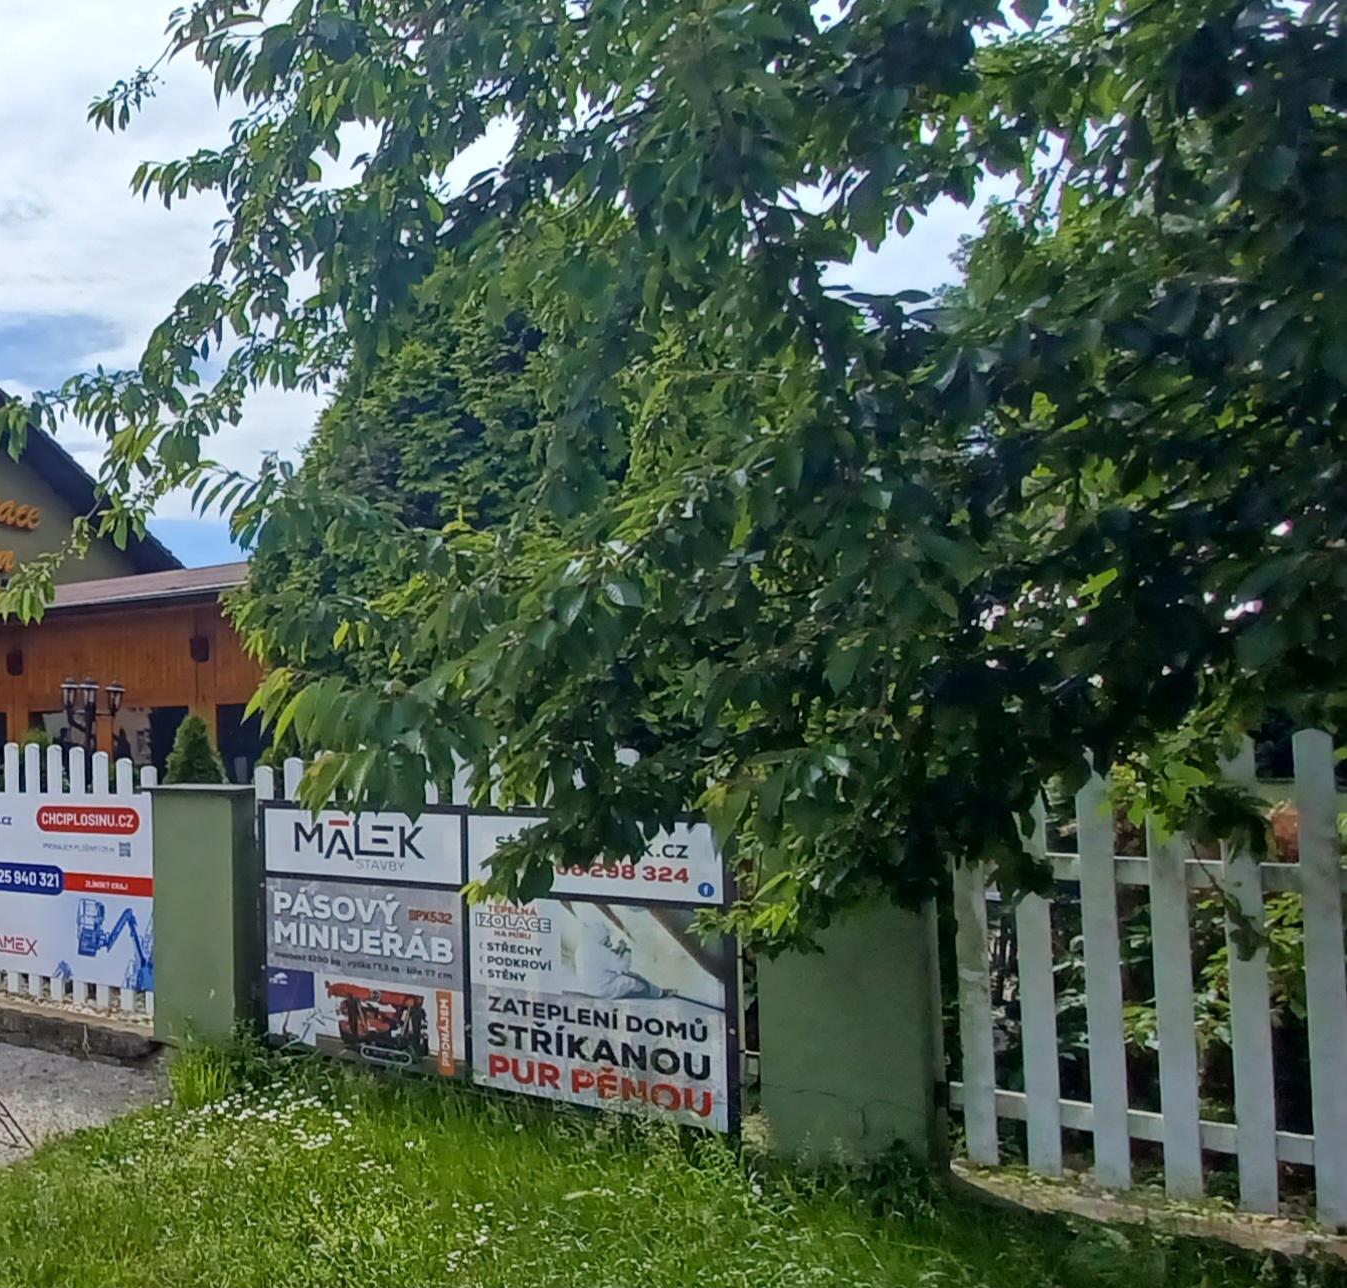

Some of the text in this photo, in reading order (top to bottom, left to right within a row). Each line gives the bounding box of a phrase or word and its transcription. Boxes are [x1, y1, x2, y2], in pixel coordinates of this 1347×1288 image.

[41, 812, 134, 828] CHCIPLOSINU.CZ
[356, 858, 405, 872] STAVBY
[643, 865, 690, 884] 324
[14, 870, 37, 886] 940
[39, 872, 60, 888] 321
[273, 887, 401, 925] PÁSOVÝ
[475, 912, 551, 934] IZOLACE
[273, 919, 453, 964] MINIJEŘÁB
[486, 941, 542, 956] STŘECHY
[487, 956, 552, 971] PODKROVÍ
[487, 968, 526, 982] STĚNY
[488, 995, 708, 1043] ZATEPLENÍ DOMŮ
[487, 1021, 711, 1081] STŘÍKANOU
[488, 1053, 713, 1118] PUR PĚNOU
